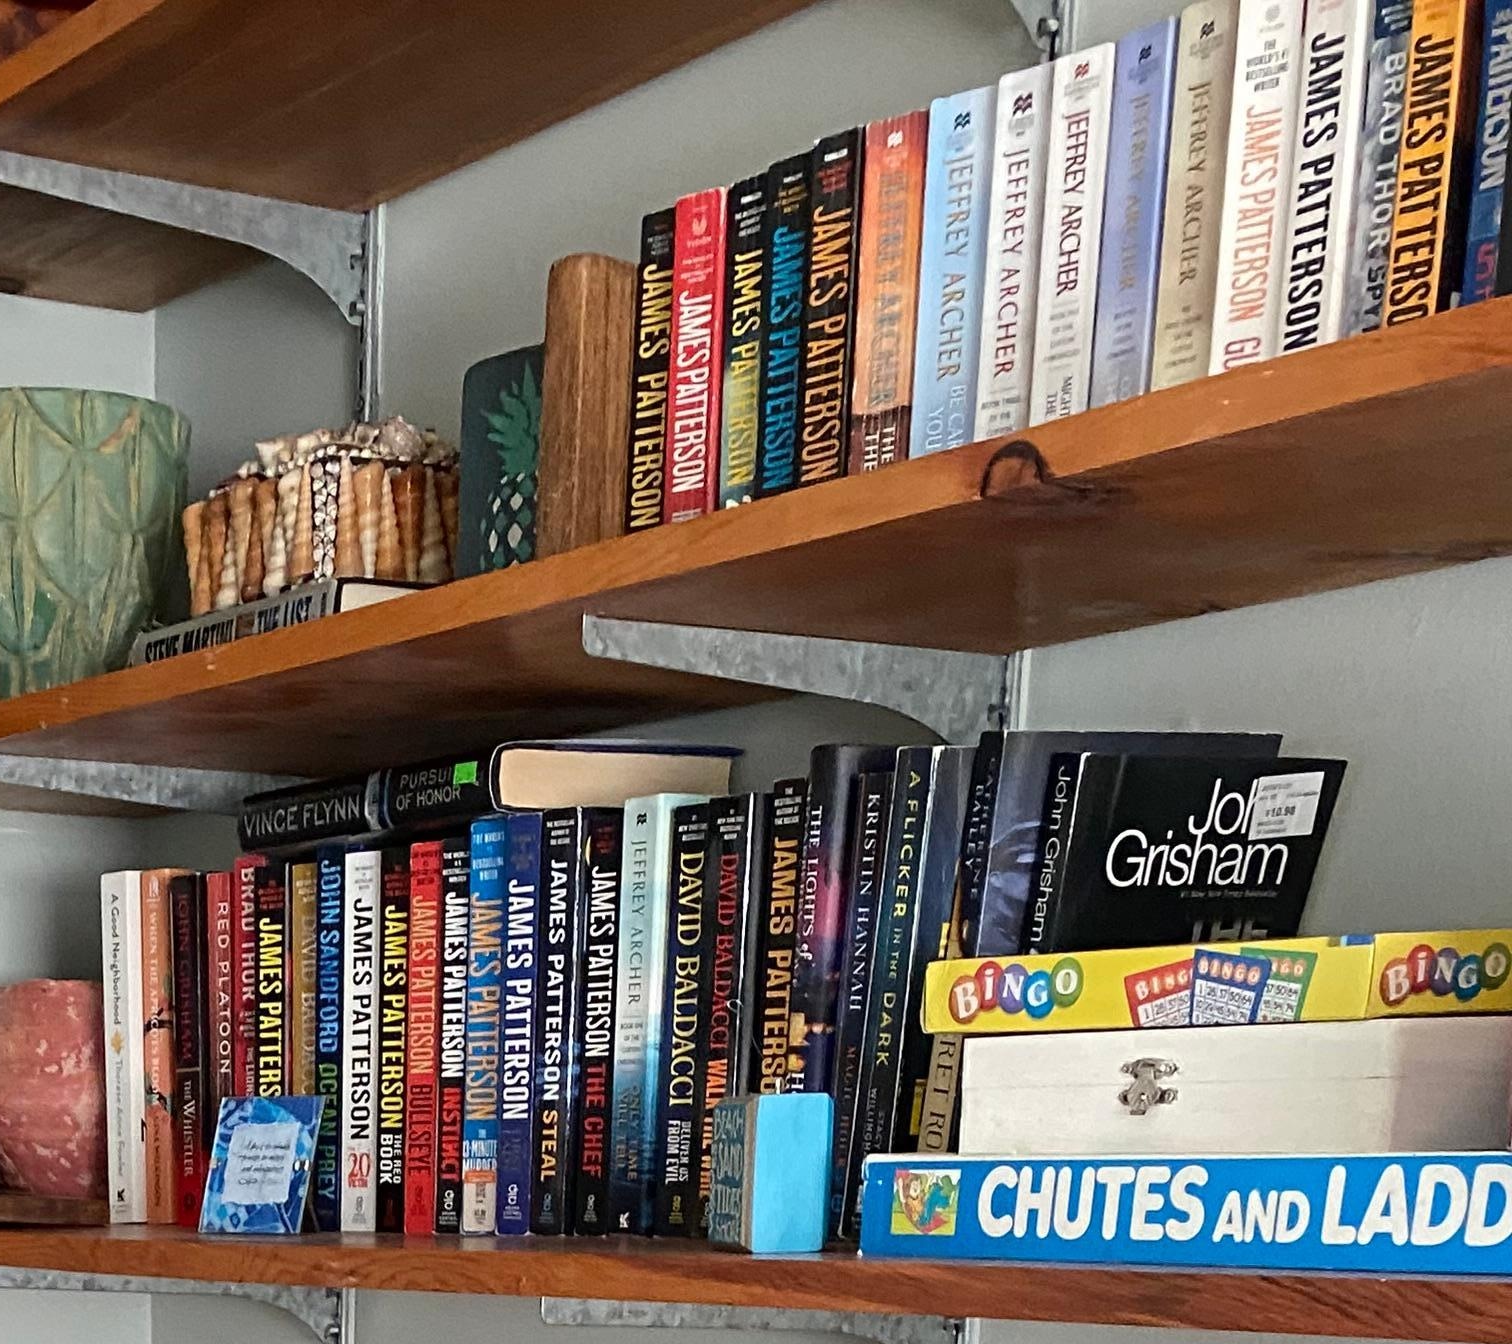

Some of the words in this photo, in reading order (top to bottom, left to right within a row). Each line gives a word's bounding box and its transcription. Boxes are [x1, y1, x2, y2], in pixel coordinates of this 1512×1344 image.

[1301, 32, 1346, 150] JAMES
[1003, 150, 1029, 256] JEFFREY
[1283, 154, 1336, 352] PATTERSON
[640, 265, 674, 359] JAMES
[994, 268, 1020, 378] ARCHER
[631, 374, 668, 527] PATTERSON
[243, 806, 297, 838] VINCE
[303, 797, 360, 828] FLYNN
[907, 772, 920, 787] A
[1054, 766, 1071, 829] John
[860, 794, 879, 895] KRISTIN
[894, 798, 915, 918] FLICKER
[1029, 833, 1060, 942] Grisham
[1106, 830, 1289, 889] Grisham
[217, 901, 228, 950] RED
[353, 897, 376, 985] JAMES
[547, 859, 567, 946] JAMES
[589, 865, 617, 937] JAMES
[679, 852, 703, 946] DAVID
[584, 942, 615, 1058] PATTERSON
[849, 907, 869, 1010] HANNAH
[217, 961, 230, 1074] PLATOON
[349, 993, 374, 1141] PATTERSON
[541, 954, 564, 1102] PATTERSON
[670, 954, 699, 1107] BALDACCI
[876, 991, 896, 1066] DARK
[541, 1109, 558, 1182] STEAL
[978, 1165, 1208, 1239] CHUTES
[1213, 1190, 1310, 1243] AND
